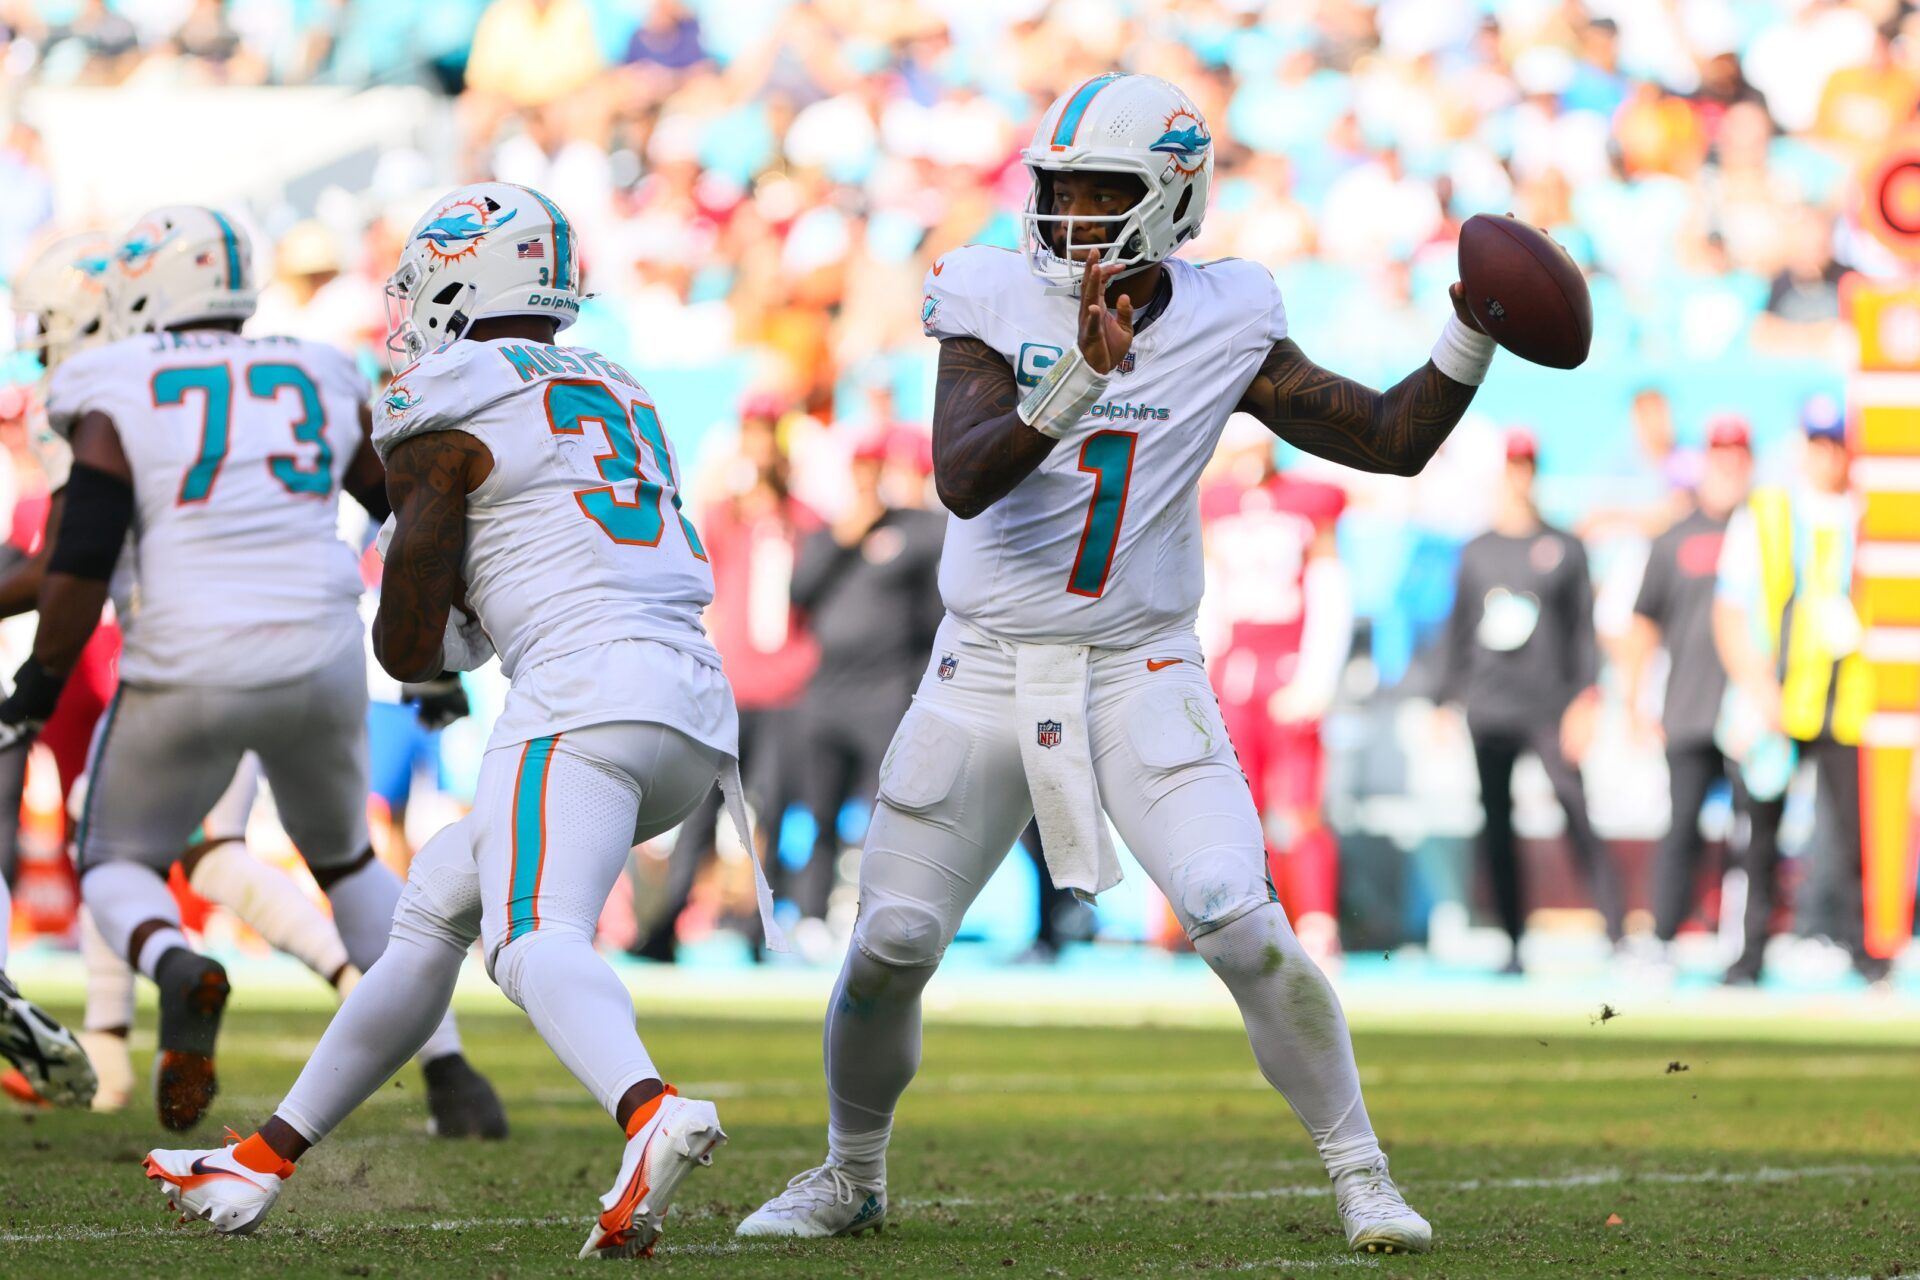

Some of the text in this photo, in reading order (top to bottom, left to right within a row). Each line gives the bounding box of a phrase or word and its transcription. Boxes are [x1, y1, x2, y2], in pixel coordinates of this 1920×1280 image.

[538, 266, 549, 287] 3
[497, 344, 647, 394] MOSTER
[1022, 346, 1059, 377] C
[1084, 400, 1171, 421] olphins
[150, 360, 334, 509] 73
[543, 379, 709, 564] 31
[1066, 429, 1139, 598] 1
[1039, 731, 1059, 746] NFL
